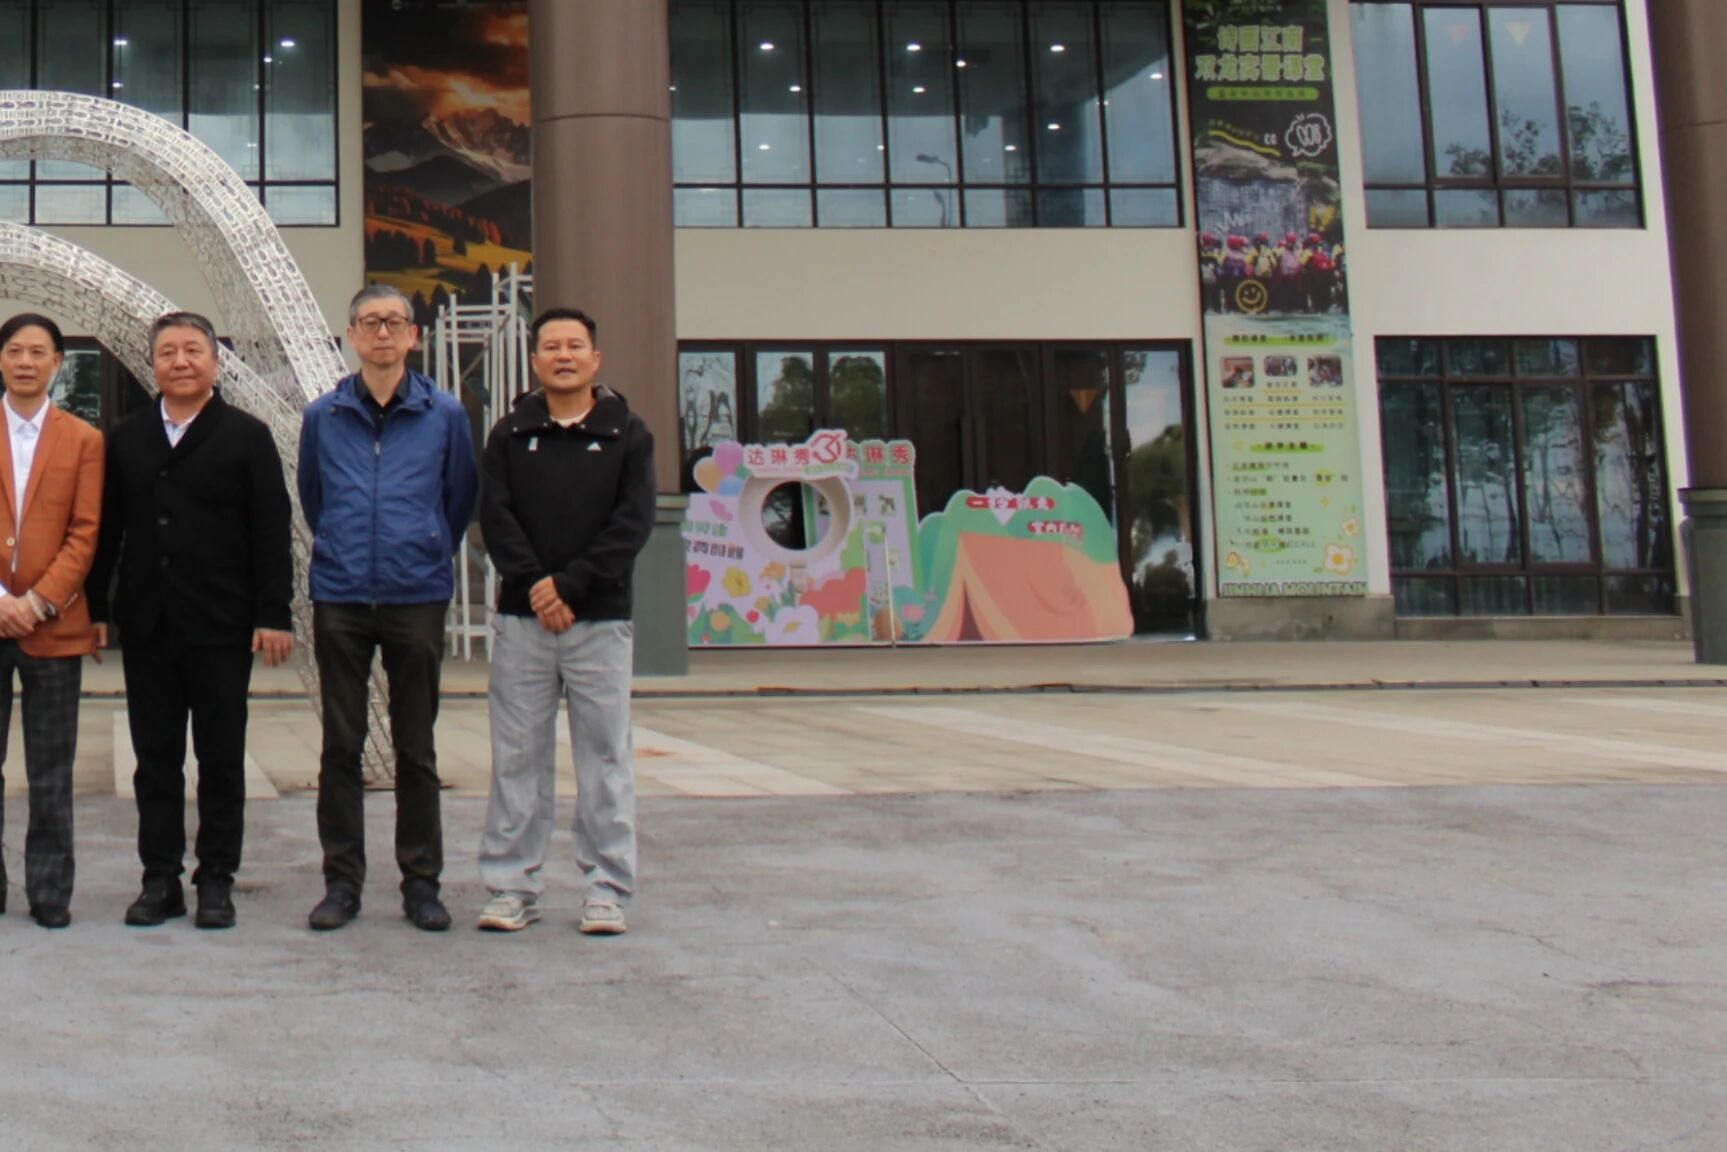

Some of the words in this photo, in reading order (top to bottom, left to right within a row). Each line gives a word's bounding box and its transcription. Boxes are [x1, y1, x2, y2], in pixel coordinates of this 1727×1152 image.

[747, 448, 810, 466] 达琳秀
[1282, 581, 1368, 597] MOUNTAIN
